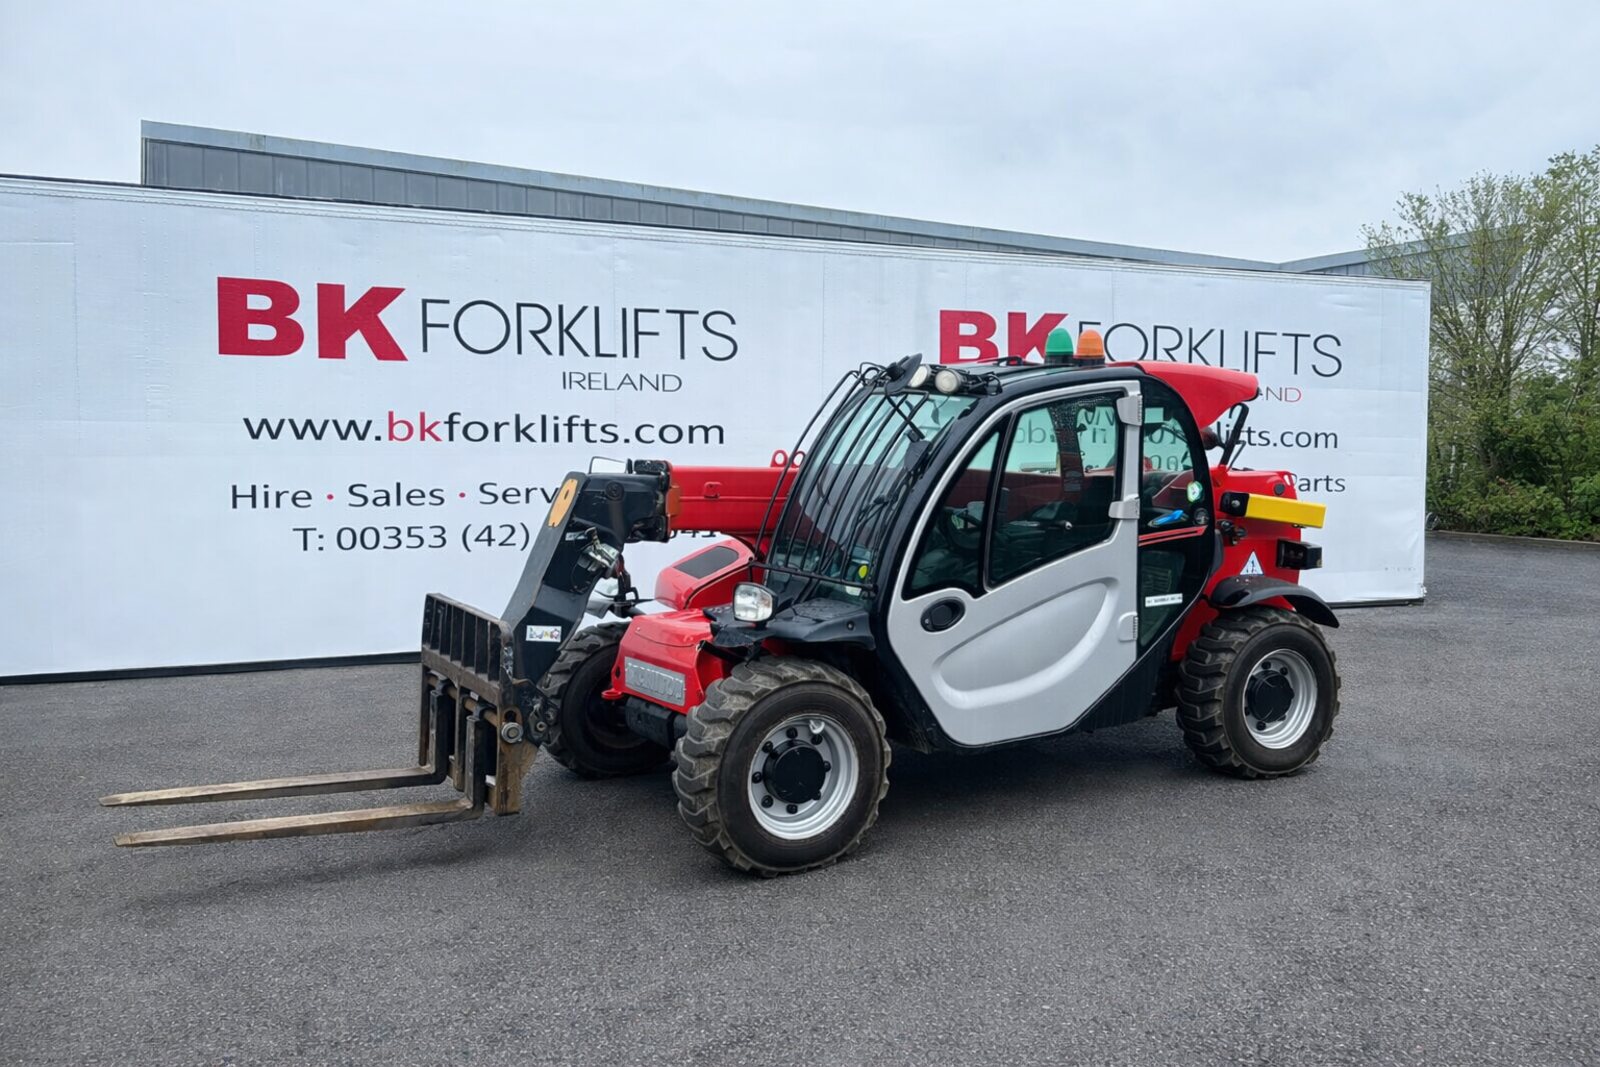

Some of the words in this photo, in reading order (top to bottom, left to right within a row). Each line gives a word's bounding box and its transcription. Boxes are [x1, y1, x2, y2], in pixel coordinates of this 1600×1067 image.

[217, 277, 408, 361] BK
[421, 298, 738, 361] FORKLIFTS
[940, 310, 1068, 363] BK
[563, 371, 682, 392] IRELAND
[243, 411, 724, 445] www.bkforklifts.com
[232, 484, 312, 509] Hire
[348, 482, 445, 508] Sales
[292, 527, 324, 552] T:
[336, 524, 448, 552] 00353
[462, 522, 530, 552] (42)
